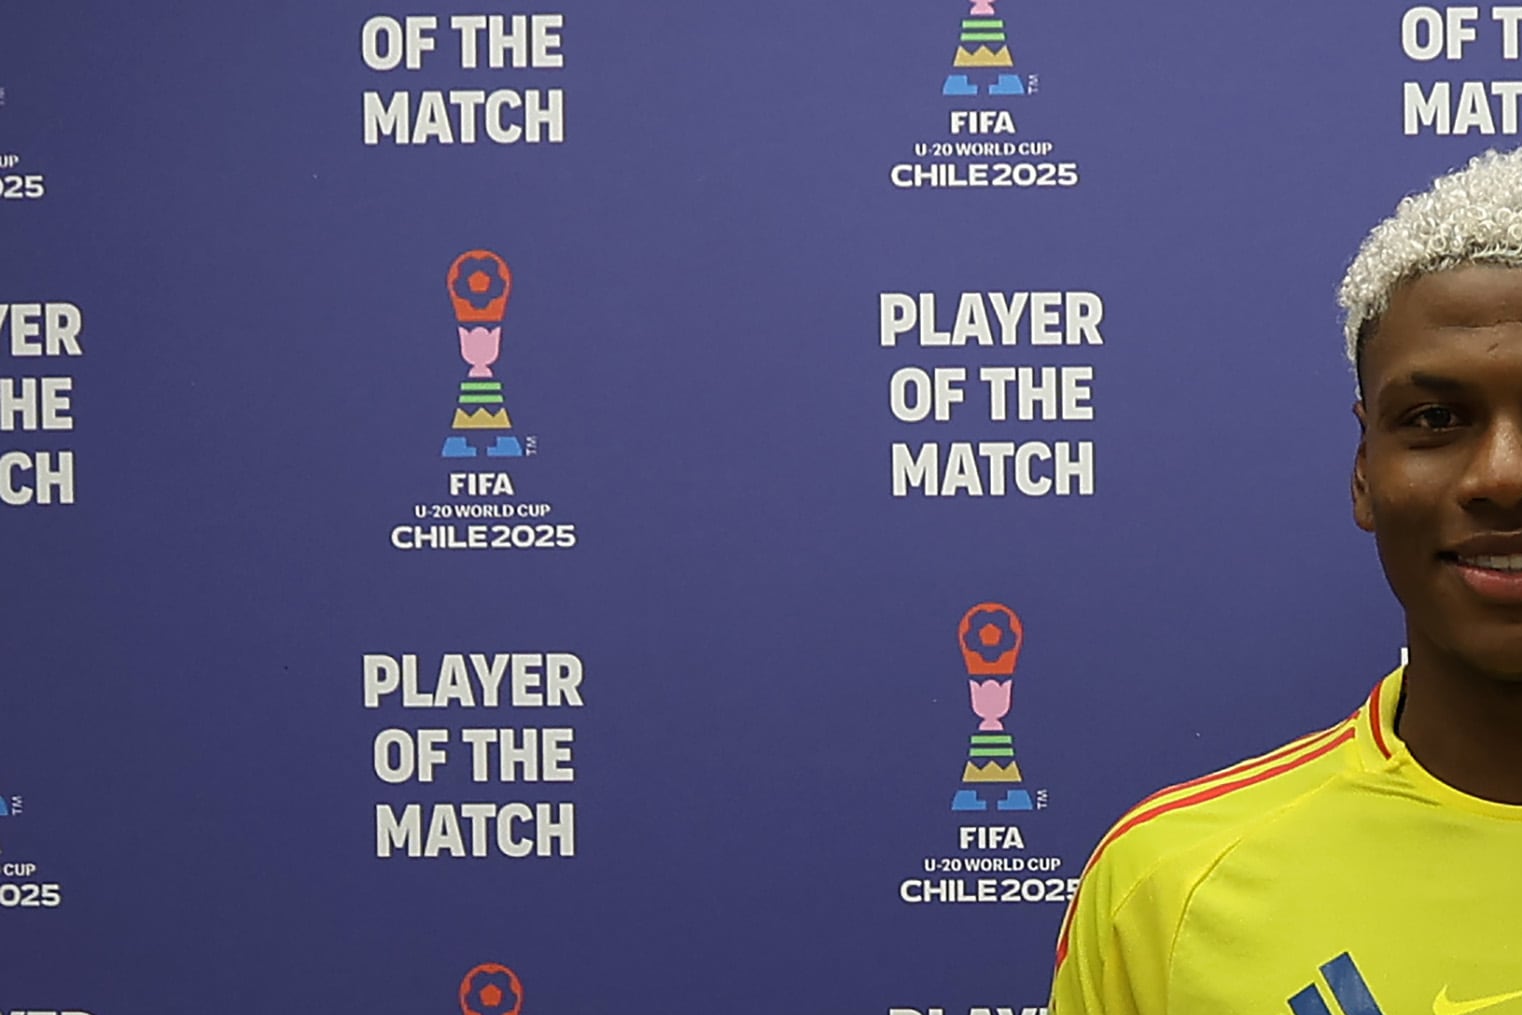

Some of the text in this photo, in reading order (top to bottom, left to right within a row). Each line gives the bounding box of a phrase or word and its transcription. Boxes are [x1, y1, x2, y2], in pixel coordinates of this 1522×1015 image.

[361, 13, 564, 71] OF THE
[1401, 5, 1479, 62] OF
[363, 88, 564, 146] MATCH
[950, 110, 1017, 136] FIFA
[914, 141, 1054, 158] U-20 WORLD CUP
[879, 290, 1104, 347] PLAYER
[0, 376, 73, 431] HE
[889, 365, 1094, 423] OF THE
[449, 472, 515, 497] FIFA
[891, 440, 1094, 497] MATCH
[414, 503, 552, 519] U-20 WORLD CUP
[362, 652, 585, 708] PLAYER
[373, 727, 574, 784] OF THE
[375, 802, 575, 858] MATCH
[959, 826, 1025, 850] FIFA
[2, 863, 36, 877] CUP
[924, 857, 1061, 872] U-20 WORLD CUP
